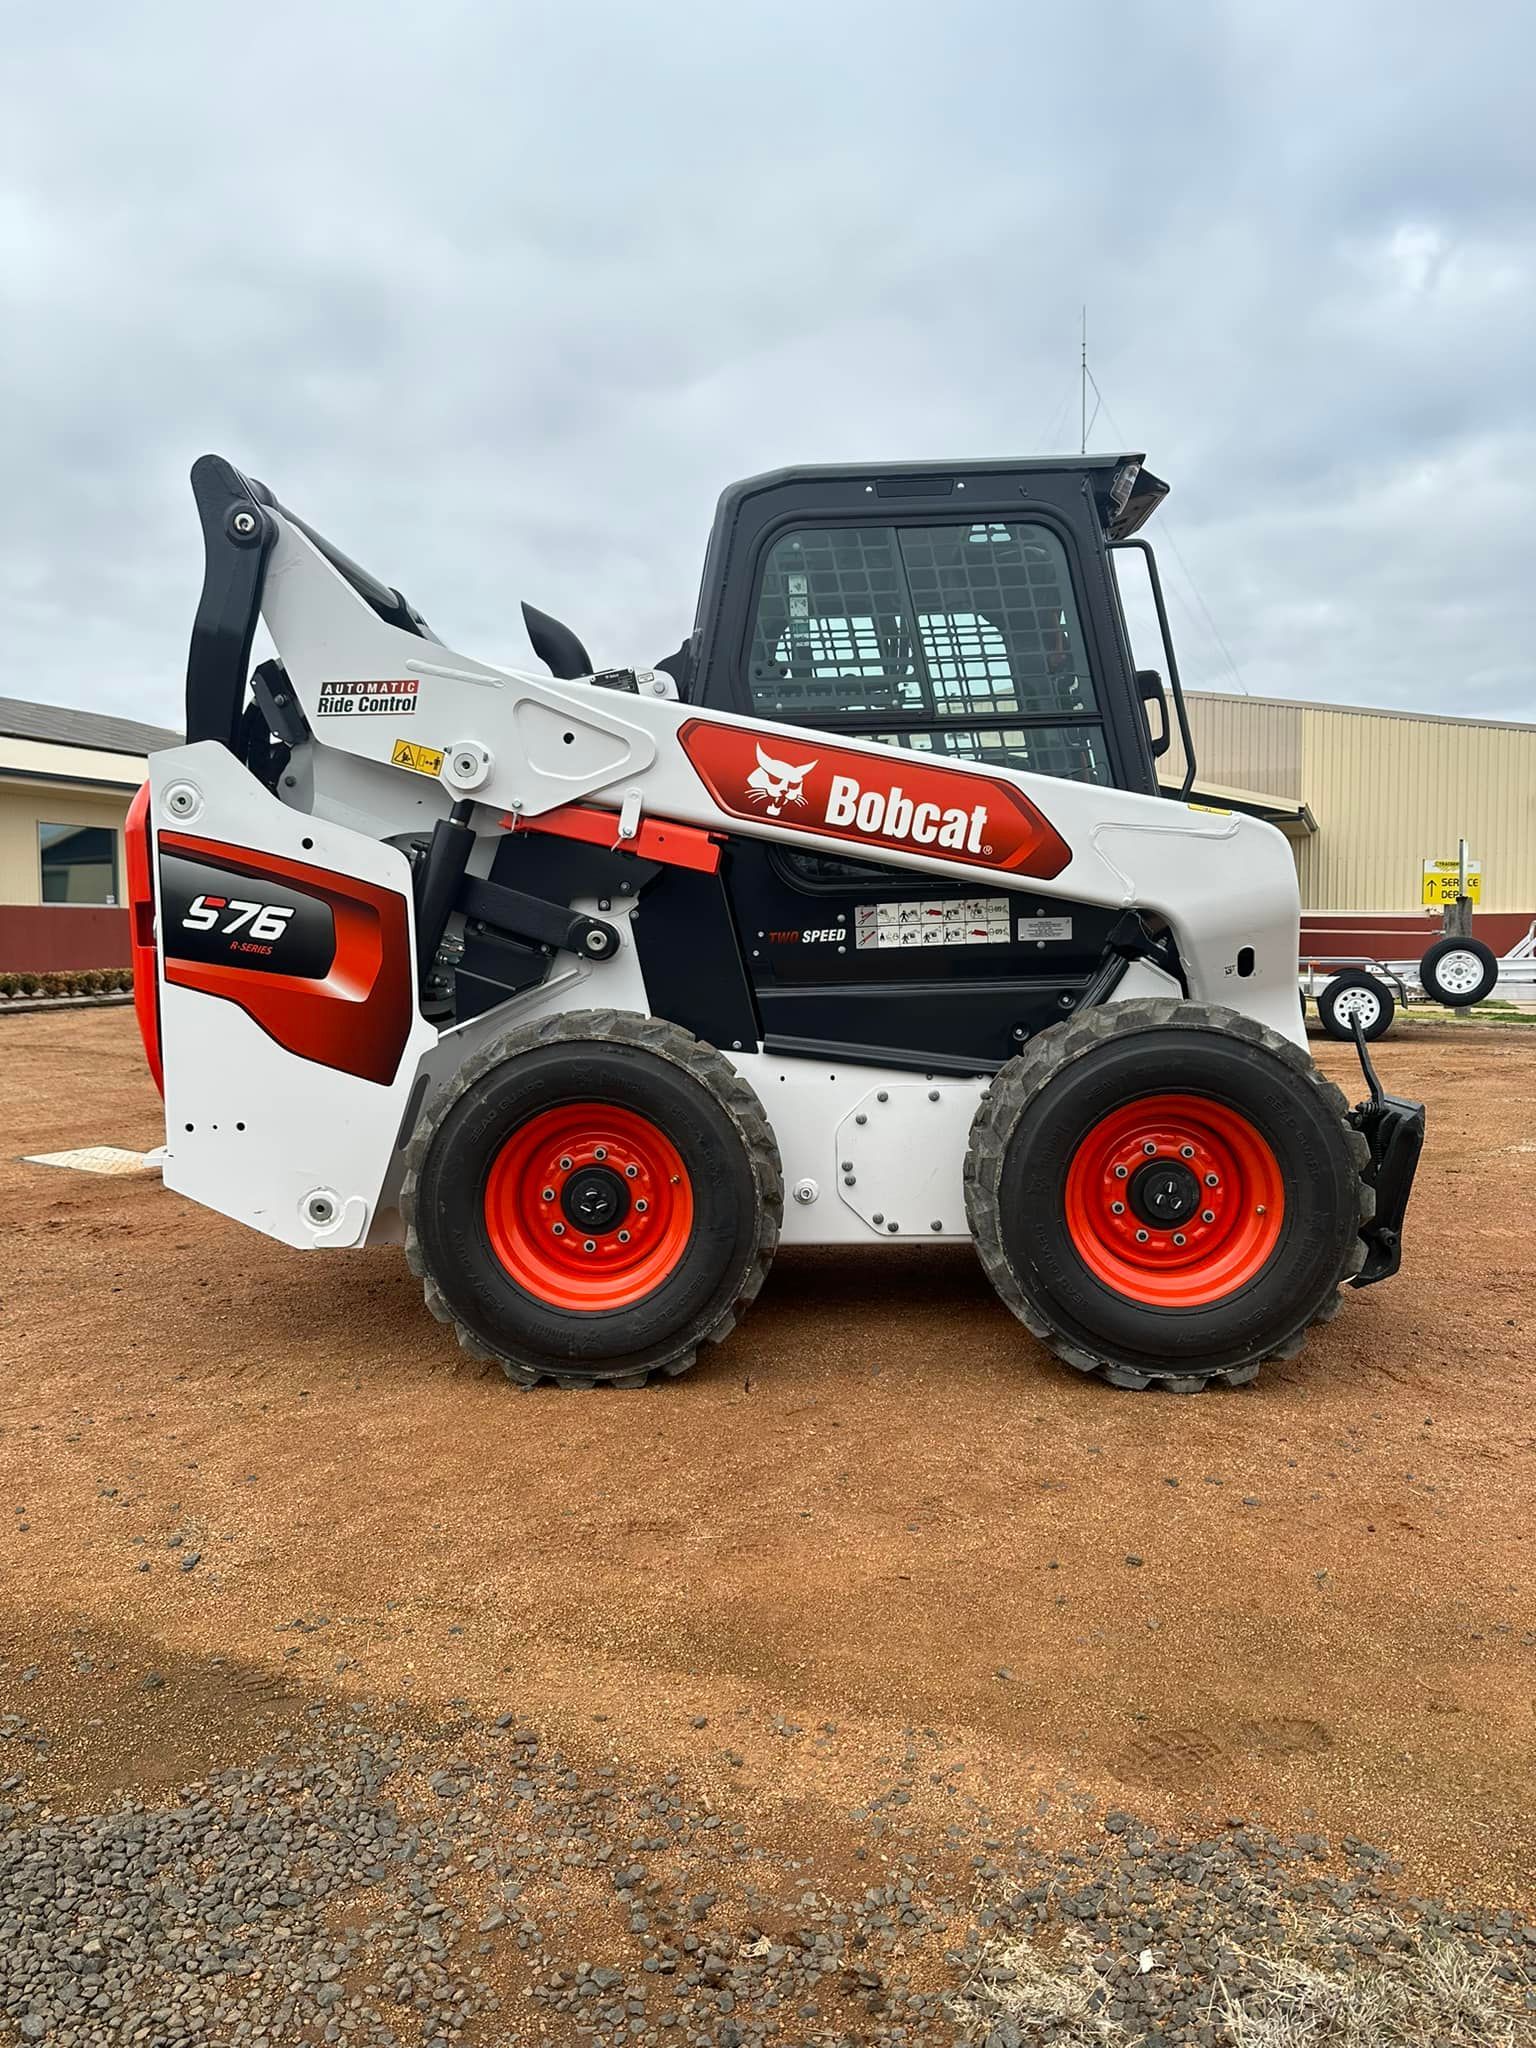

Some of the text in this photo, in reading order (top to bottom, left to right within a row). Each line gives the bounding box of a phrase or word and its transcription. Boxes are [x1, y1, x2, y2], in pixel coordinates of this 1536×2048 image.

[324, 682, 416, 694] AUTOMATIC
[317, 695, 417, 713] Ride Control
[824, 775, 989, 854] Bobcat
[1441, 878, 1479, 887] SERCE
[1441, 890, 1460, 899] DEP
[181, 895, 295, 941] S76
[769, 928, 846, 944] TWO SPEED
[230, 941, 273, 955] R-SERIES
